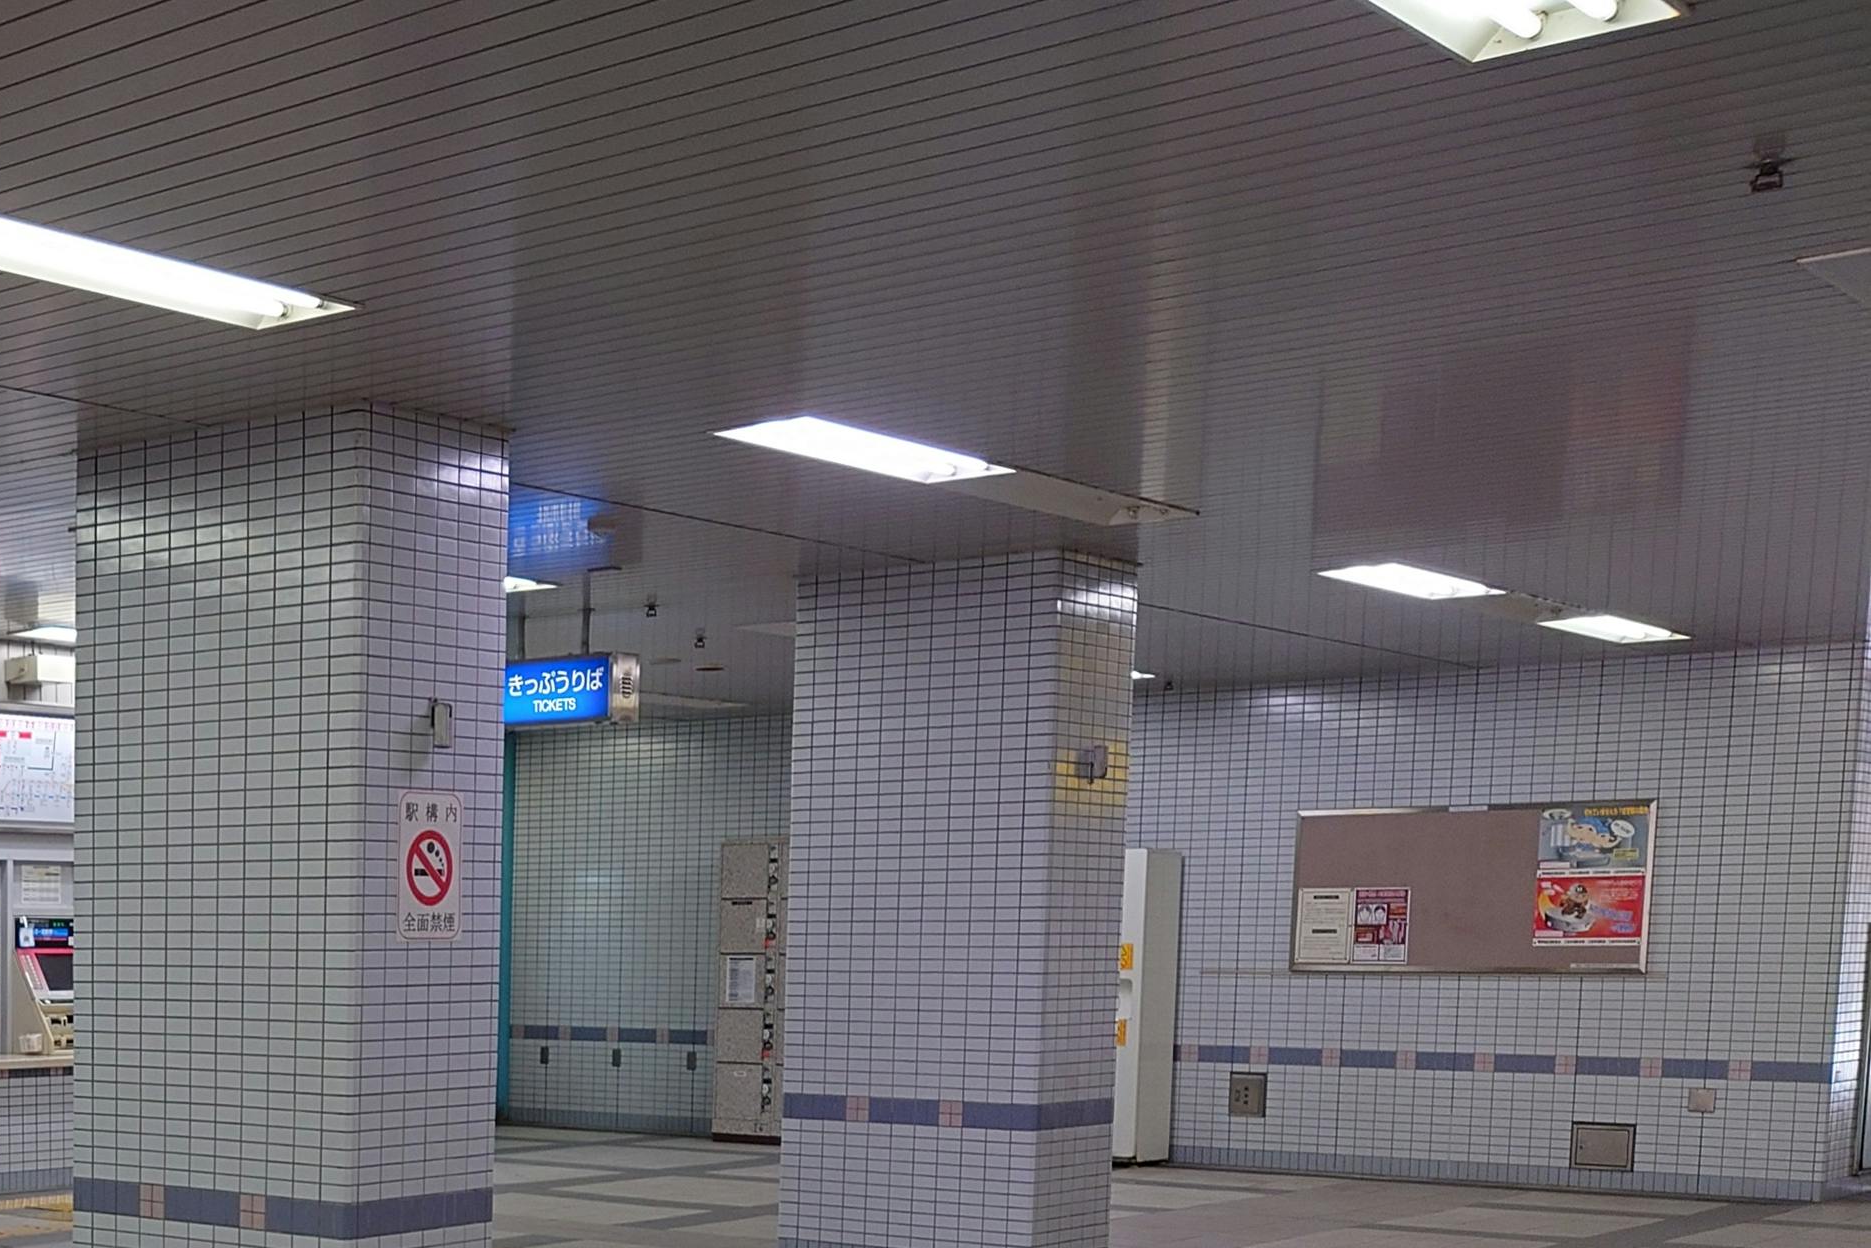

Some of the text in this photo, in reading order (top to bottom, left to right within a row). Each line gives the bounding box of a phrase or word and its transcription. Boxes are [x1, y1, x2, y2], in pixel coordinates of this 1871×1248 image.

[508, 666, 605, 697] きっぷうりば
[532, 697, 577, 713] TICKETS
[405, 802, 458, 823] 駅構内
[402, 911, 456, 933] 全面禁煙
